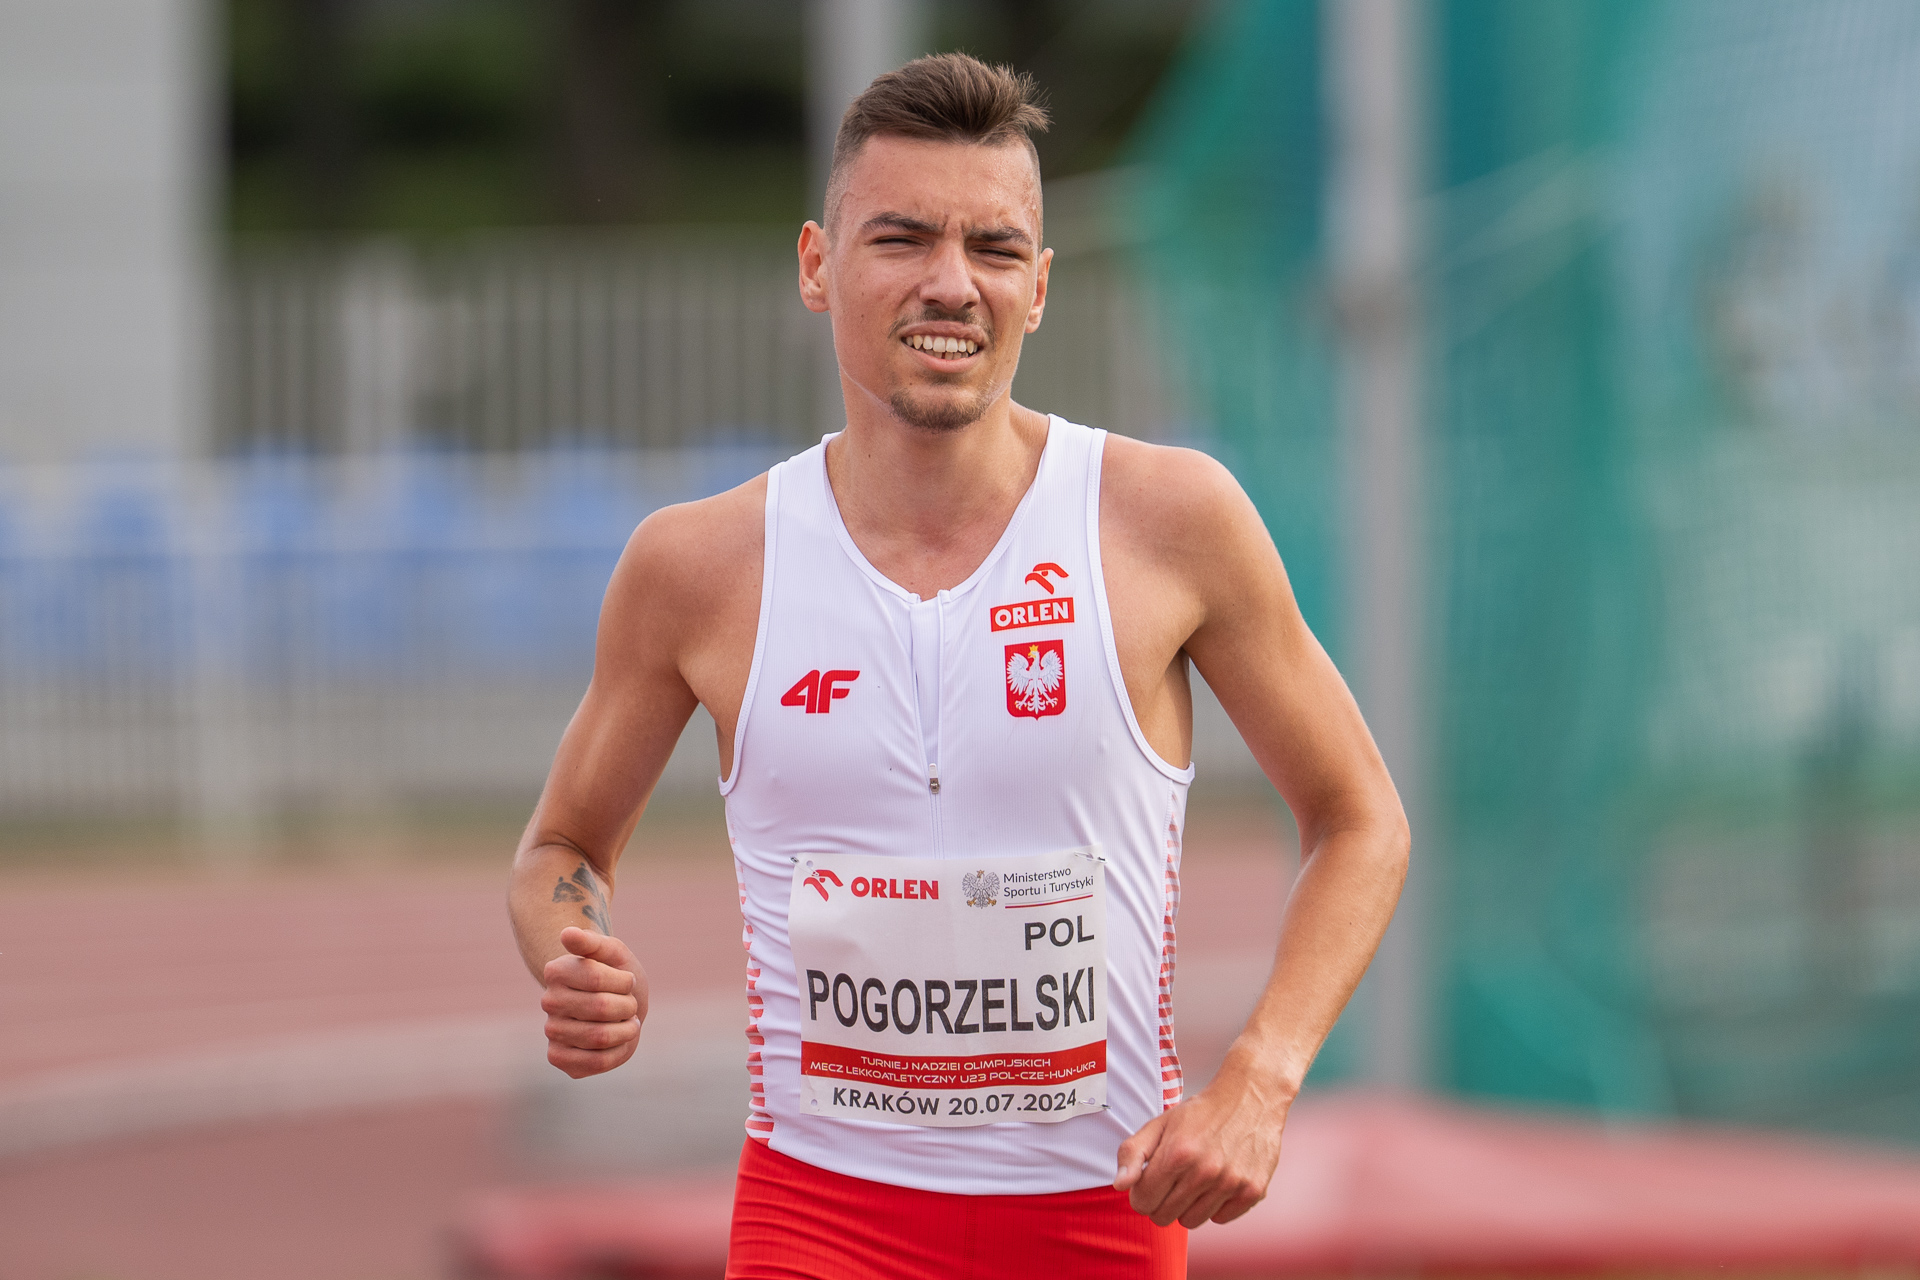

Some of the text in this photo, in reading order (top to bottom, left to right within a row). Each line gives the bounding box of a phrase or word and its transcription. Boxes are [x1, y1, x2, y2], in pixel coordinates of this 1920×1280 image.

[994, 601, 1069, 627] ORLEN
[780, 669, 861, 714] 4F
[850, 876, 940, 900] ORLEN
[1003, 868, 1072, 884] Ministerstwo
[1003, 875, 1094, 899] Sportu i Turystyki
[1024, 914, 1095, 951] POL
[805, 966, 1096, 1035] POGORZELSKI
[810, 1060, 1097, 1084] MECZ LEKKOATLETYCZNY U23 POL-CZE-HUN-UKR
[860, 1055, 1051, 1071] TURNIEJ NADZIEI OLIMPIJSKICH
[832, 1086, 1077, 1116] KRAKÓW 20.07.2024
